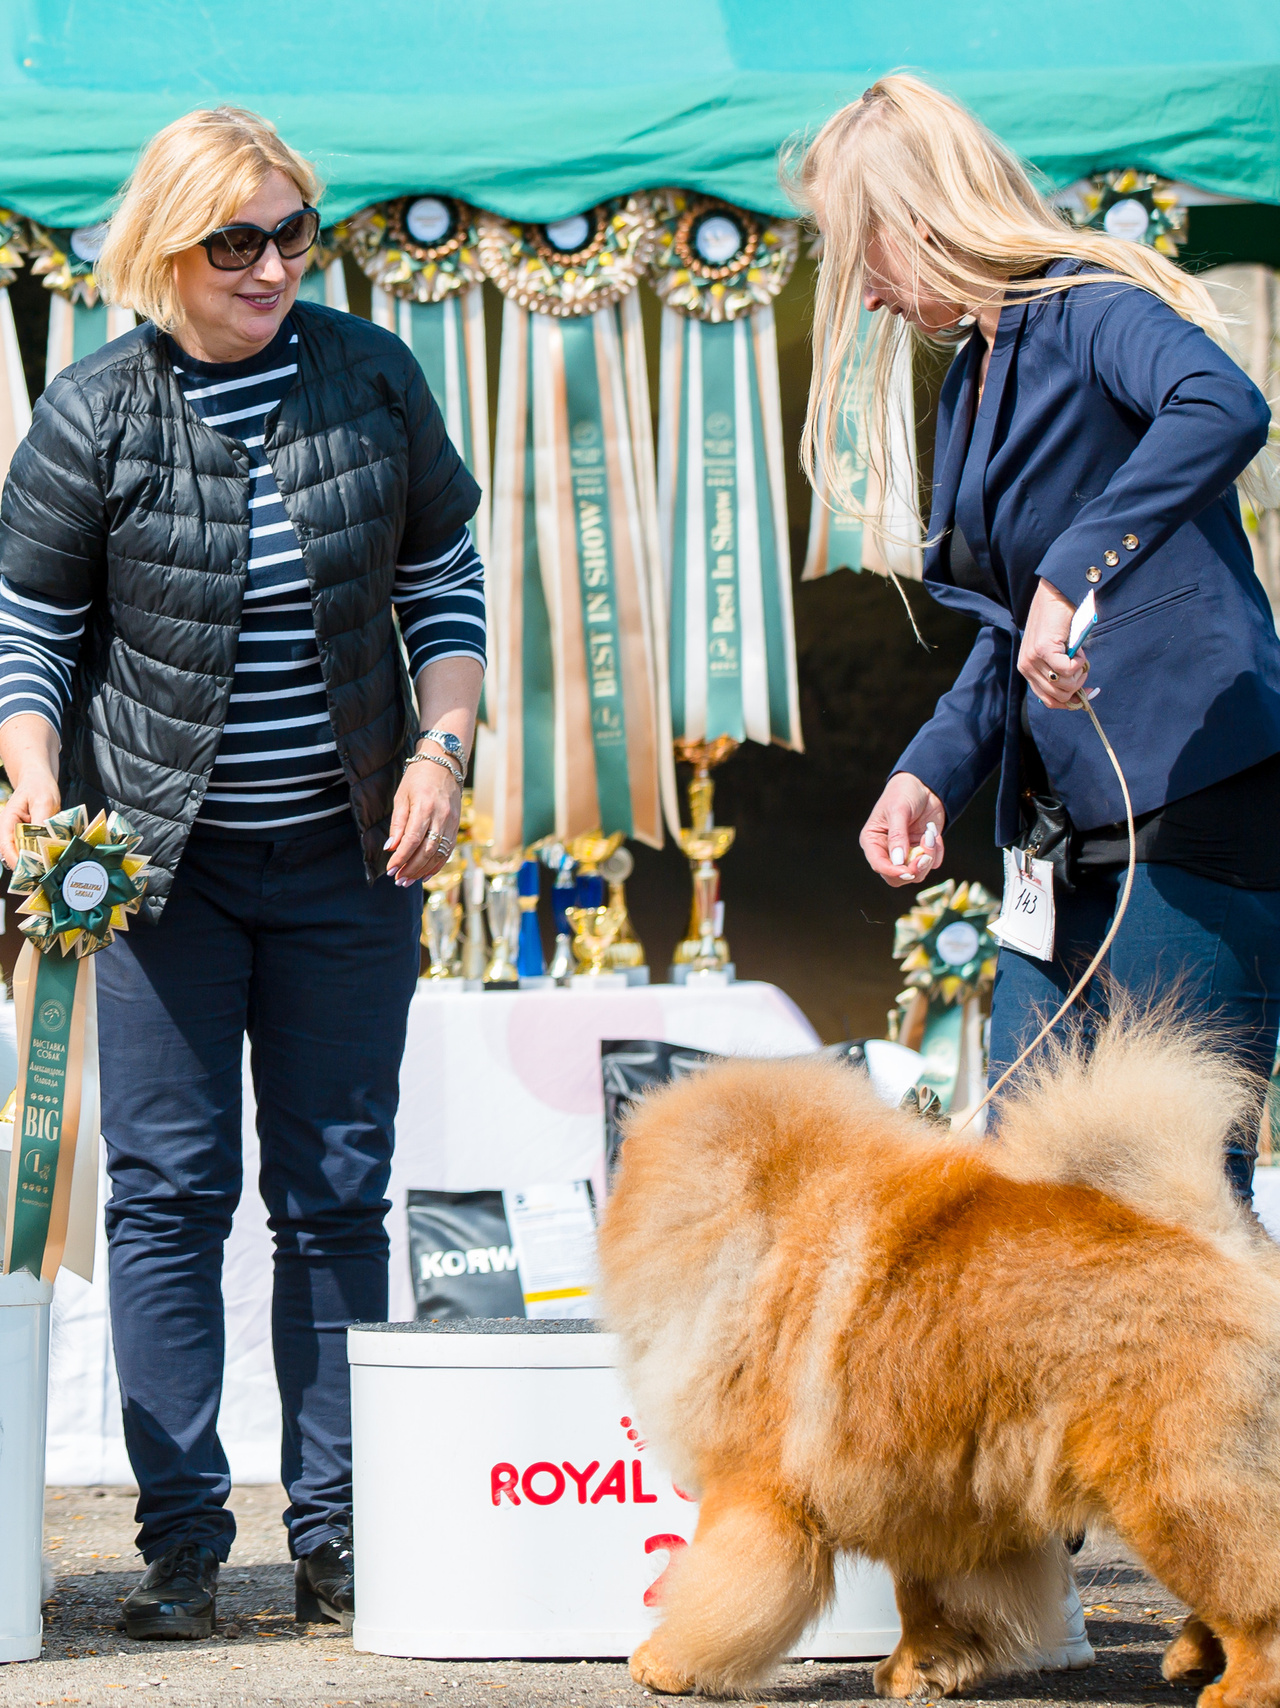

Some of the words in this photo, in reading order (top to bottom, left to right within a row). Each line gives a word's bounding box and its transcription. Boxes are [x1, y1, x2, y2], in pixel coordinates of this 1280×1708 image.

[712, 490, 734, 552] Show
[580, 500, 607, 588] SHOW
[712, 555, 734, 579] In
[588, 592, 611, 623] IN
[712, 584, 735, 633] Best
[590, 632, 617, 698] BEST
[1014, 888, 1038, 914] 143
[33, 1038, 65, 1053] ВЫСТАВКА
[36, 1049, 60, 1062] СОБАК
[24, 1105, 59, 1142] BIG
[33, 1153, 40, 1172] 1
[491, 1459, 658, 1506] ROYAL
